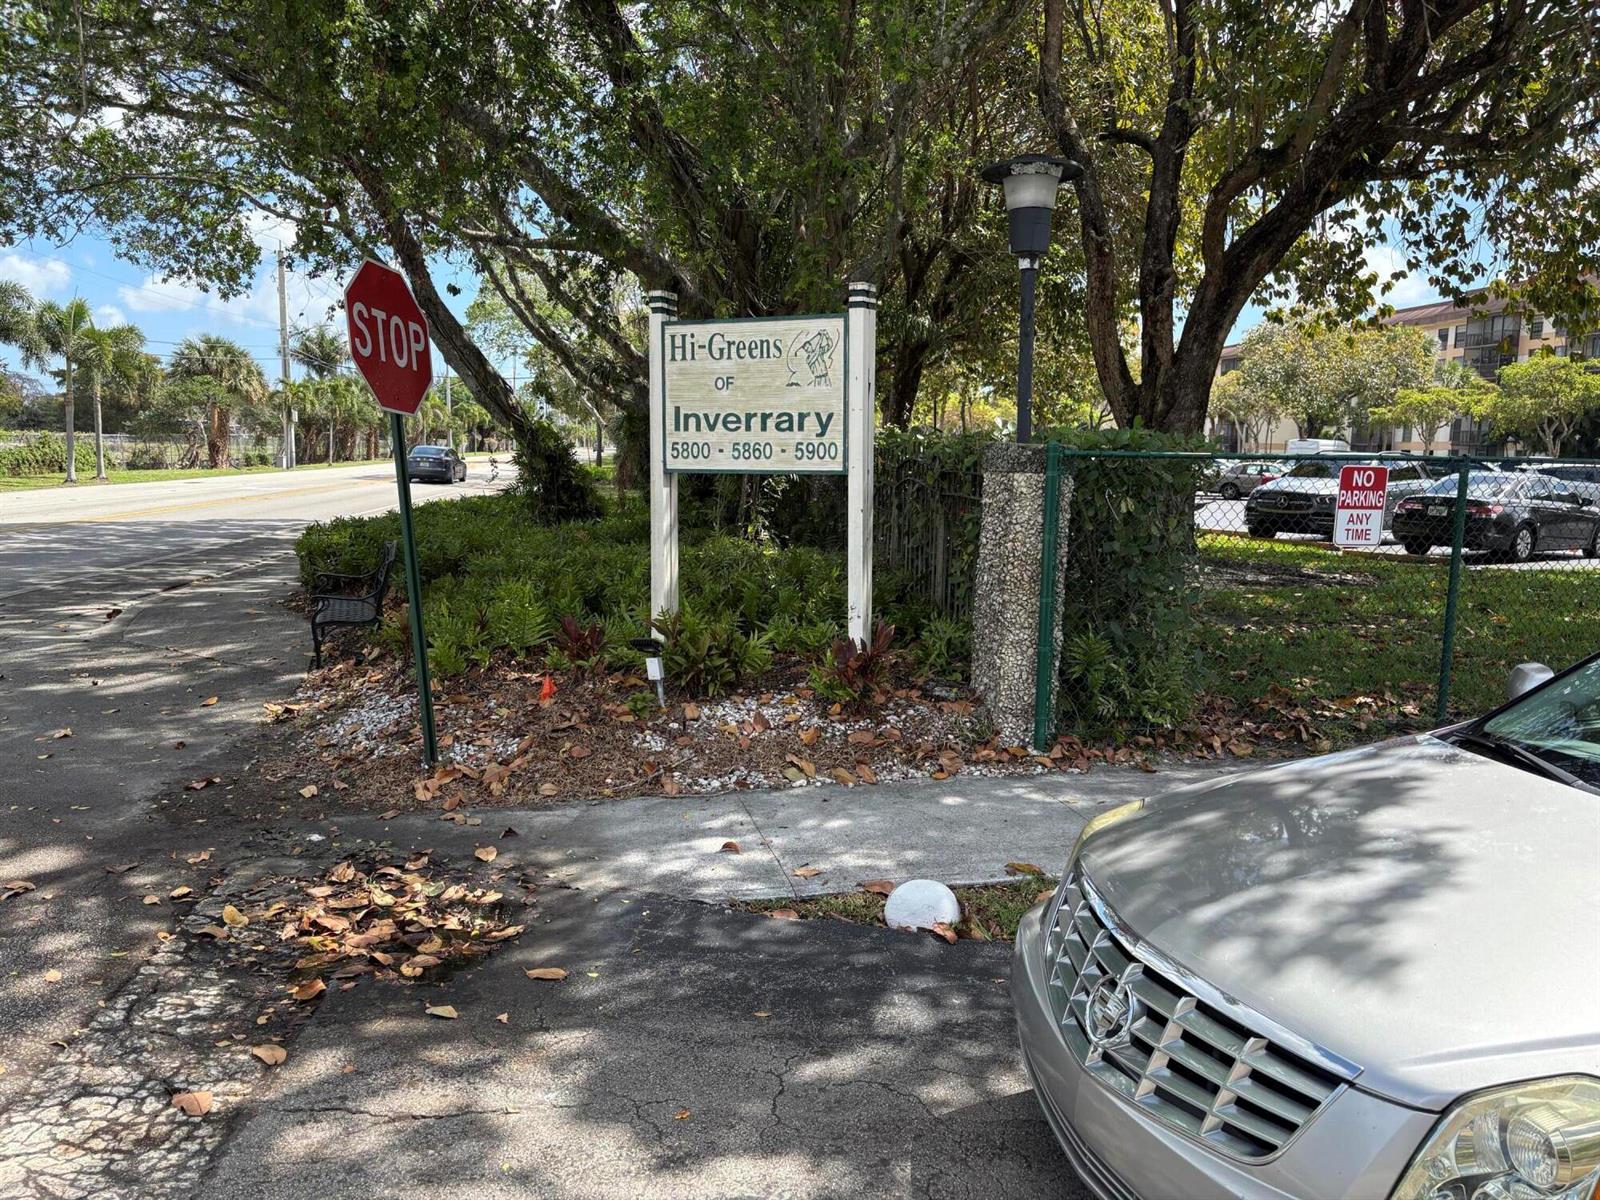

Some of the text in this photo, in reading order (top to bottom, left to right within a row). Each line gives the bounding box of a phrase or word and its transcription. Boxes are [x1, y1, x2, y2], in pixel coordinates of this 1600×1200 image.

[352, 302, 425, 372] STOP
[669, 332, 783, 362] Hi-Greens
[714, 376, 735, 391] OF
[674, 406, 834, 437] Inverrary
[671, 442, 711, 459] 5800
[731, 442, 773, 460] 5860
[794, 442, 838, 460] 5900
[1352, 470, 1375, 487] NO
[1339, 490, 1384, 507] PARKING
[1346, 513, 1372, 525] ANY
[1345, 529, 1371, 541] TIME
